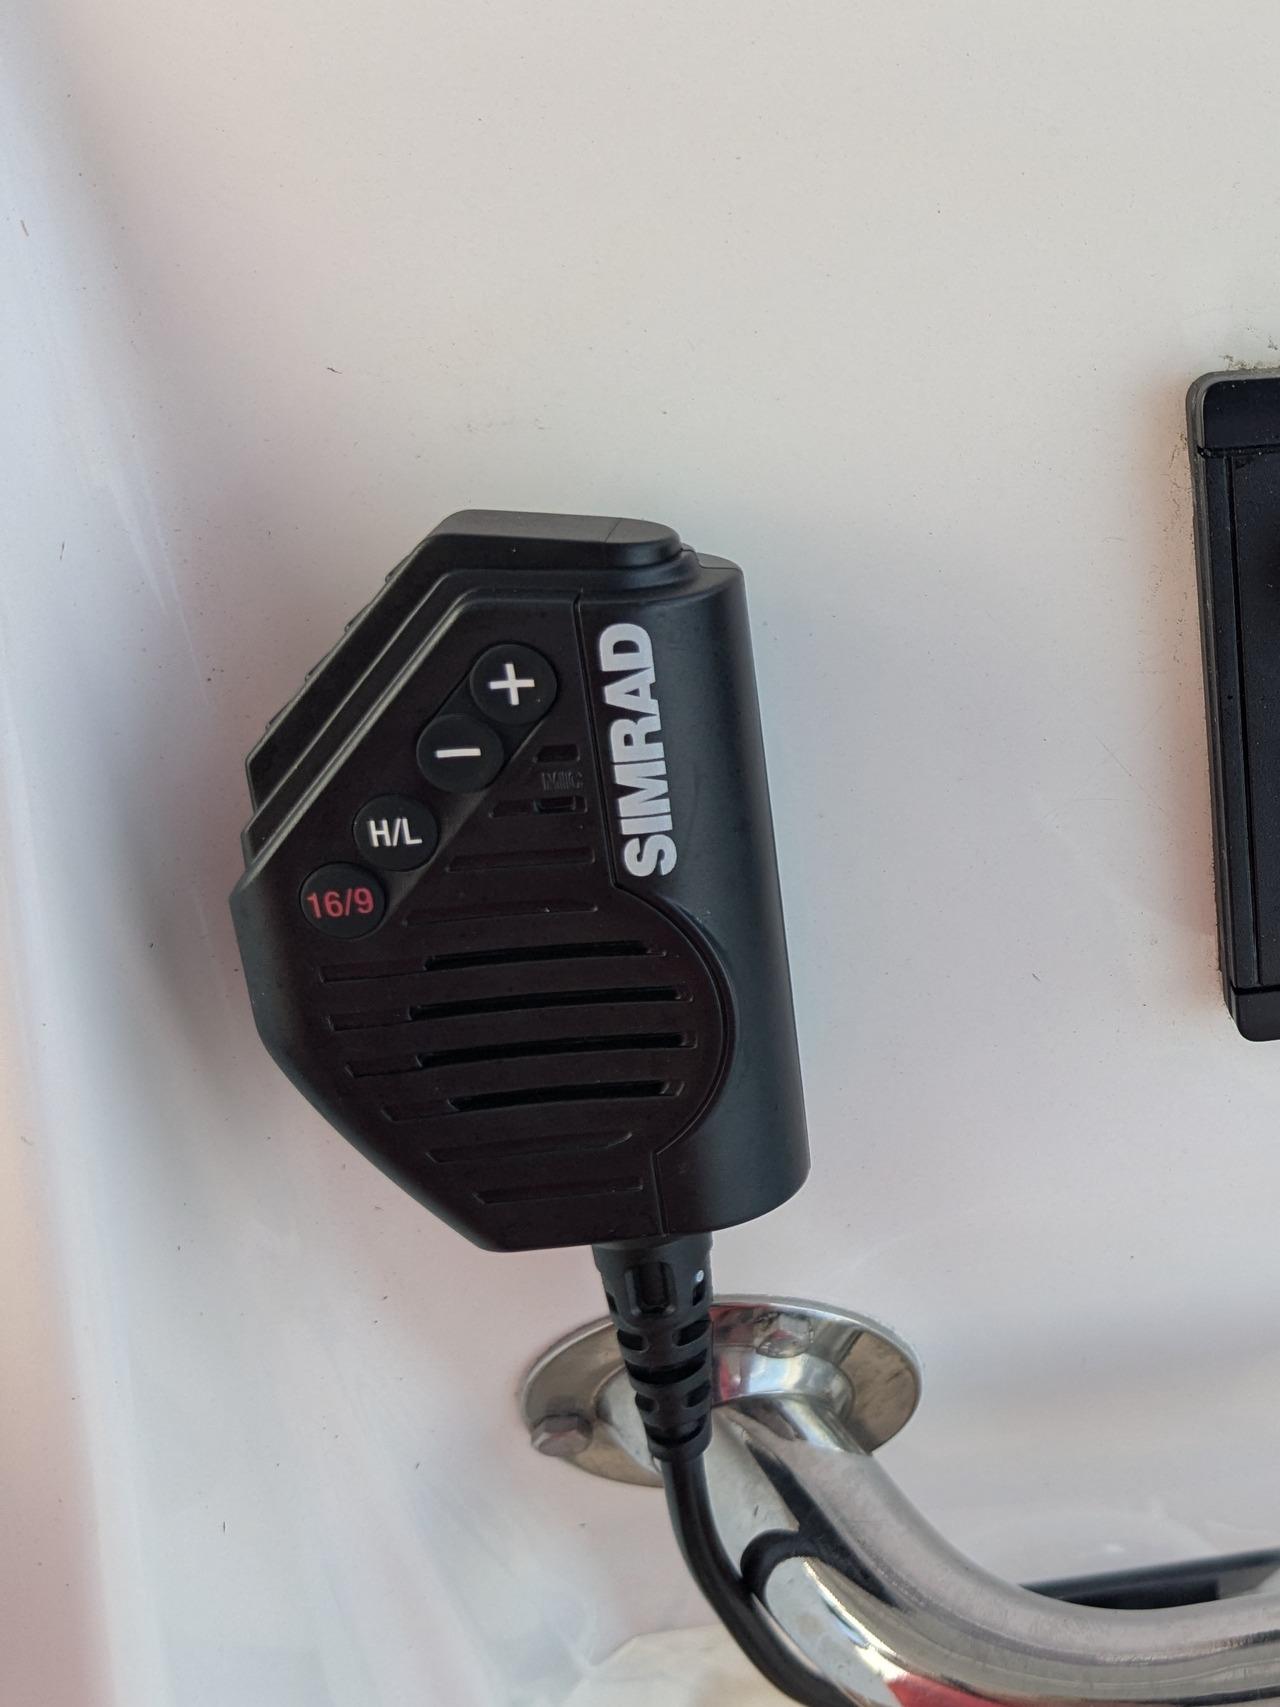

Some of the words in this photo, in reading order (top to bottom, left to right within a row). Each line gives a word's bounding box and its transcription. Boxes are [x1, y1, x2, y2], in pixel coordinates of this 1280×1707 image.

[600, 623, 678, 877] SIMRAD
[367, 818, 423, 849] H/L
[307, 887, 375, 920] 16/9
